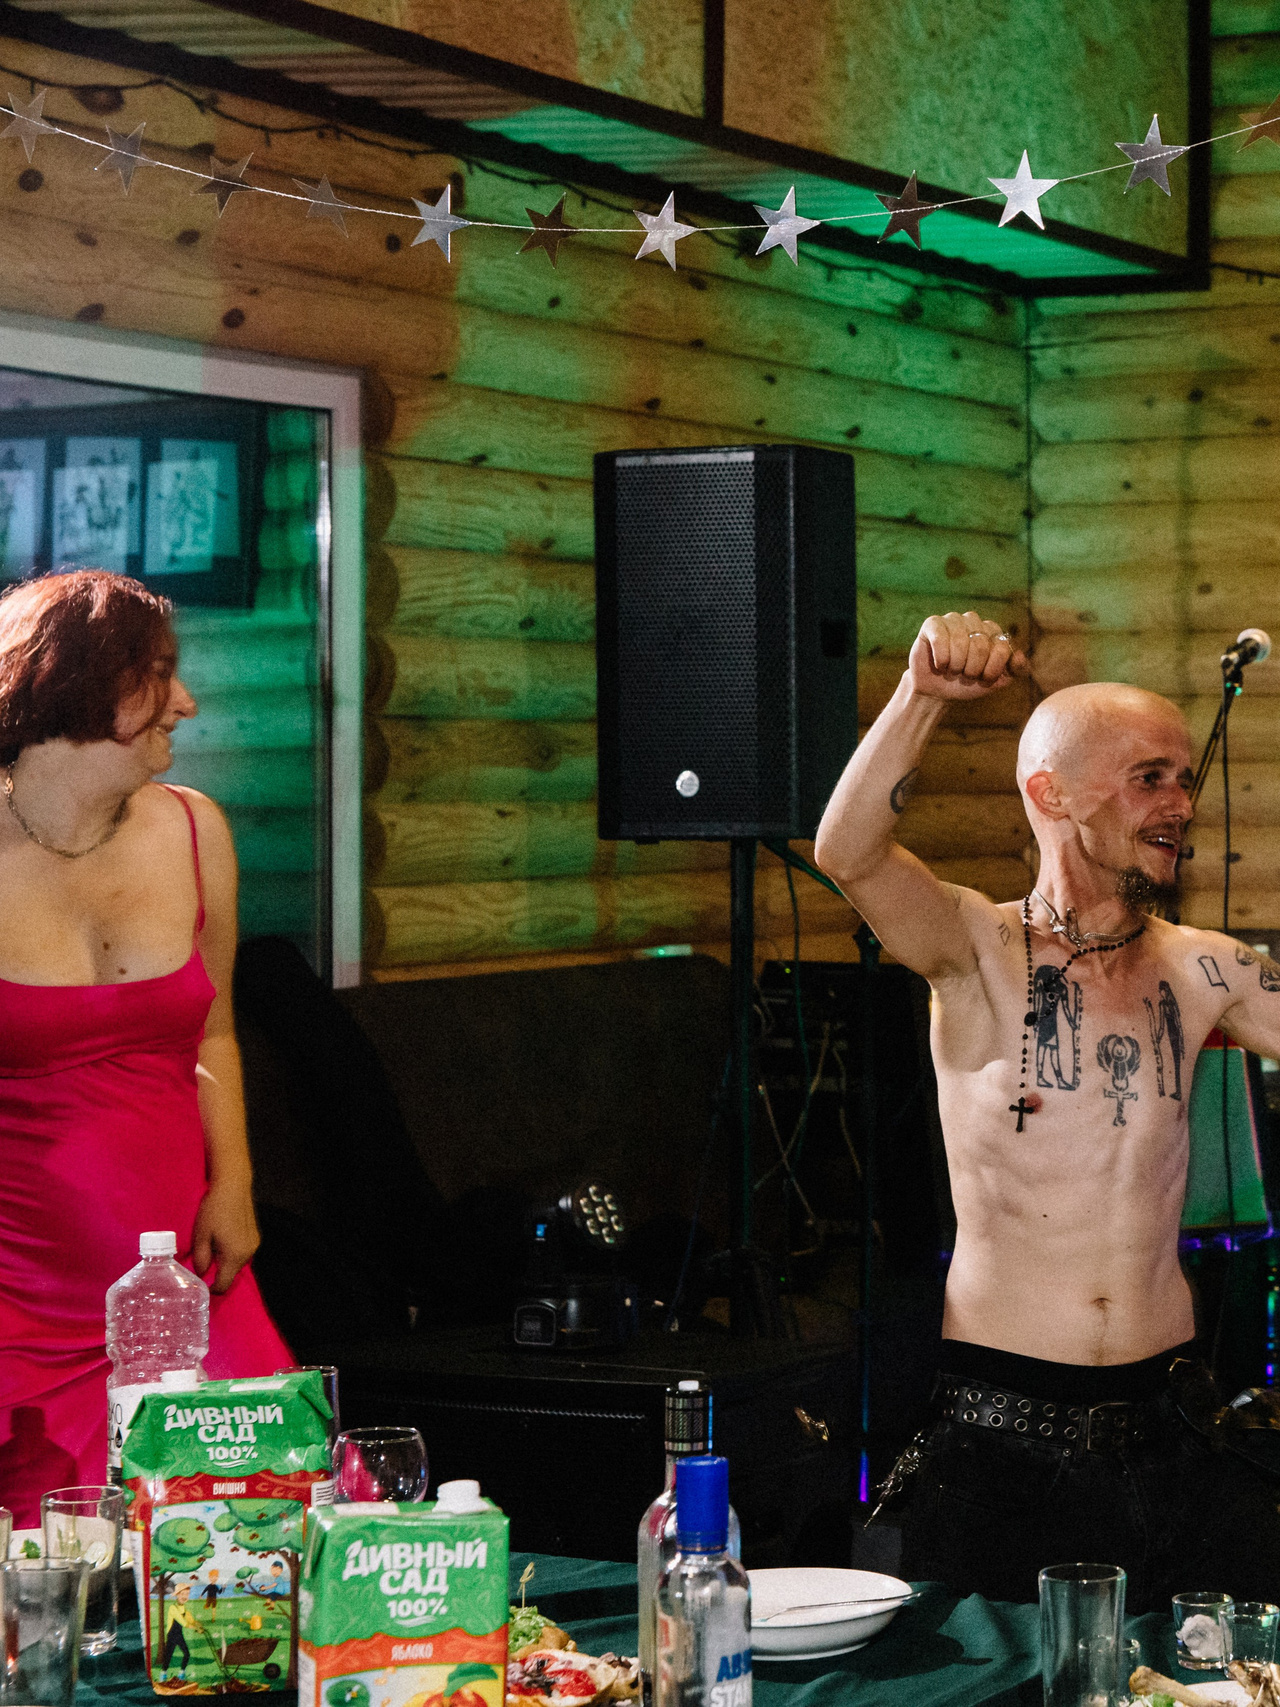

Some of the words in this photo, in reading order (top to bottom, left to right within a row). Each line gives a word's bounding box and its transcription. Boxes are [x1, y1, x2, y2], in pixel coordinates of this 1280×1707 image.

[163, 1403, 284, 1432] ДИВНЫЙ
[197, 1424, 258, 1444] САД
[206, 1446, 259, 1463] 100%
[212, 1481, 247, 1496] ВИШНЯ
[341, 1537, 488, 1582] ДИВНЫЙ
[379, 1567, 450, 1596] САД
[386, 1598, 449, 1618] 100%
[391, 1643, 434, 1661] ЯБЛОКО
